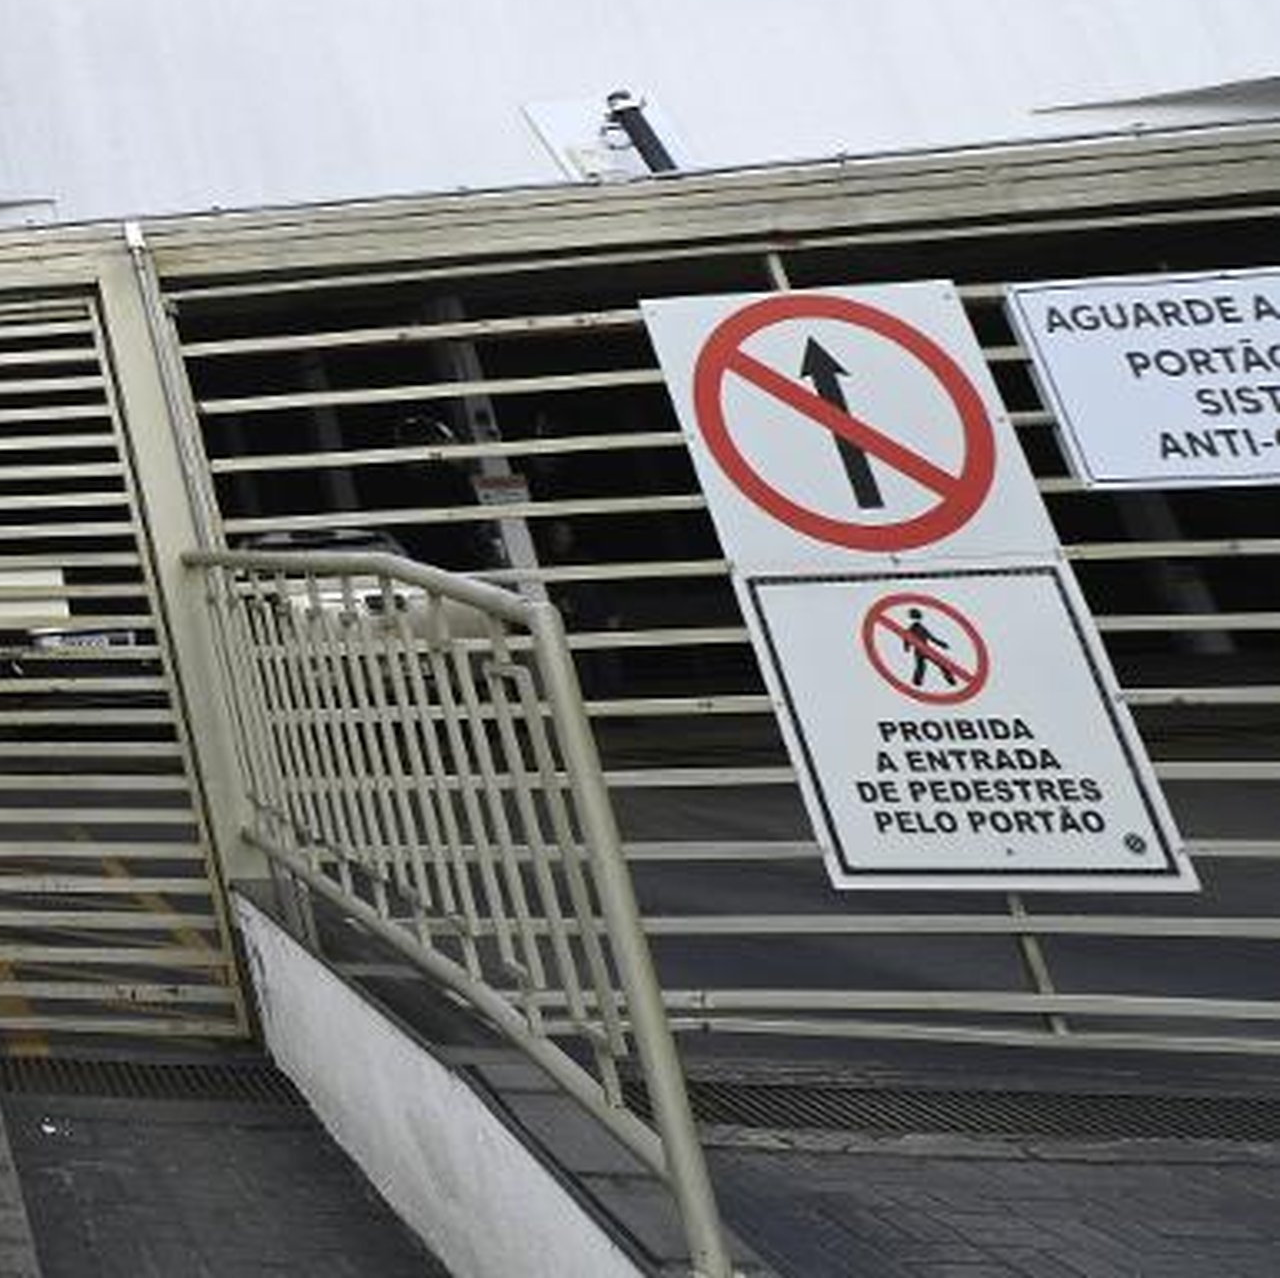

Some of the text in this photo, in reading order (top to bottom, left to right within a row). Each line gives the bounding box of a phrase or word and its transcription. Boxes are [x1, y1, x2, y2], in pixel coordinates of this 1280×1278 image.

[1046, 296, 1244, 334] AGUARDE
[1159, 427, 1280, 461] ANTI-
[877, 717, 1035, 743] PROIBIDA
[876, 747, 1062, 773] A ENTRADA
[855, 777, 1104, 804] DE PEDESTRES
[873, 805, 1106, 834] PELO PORTÃO
